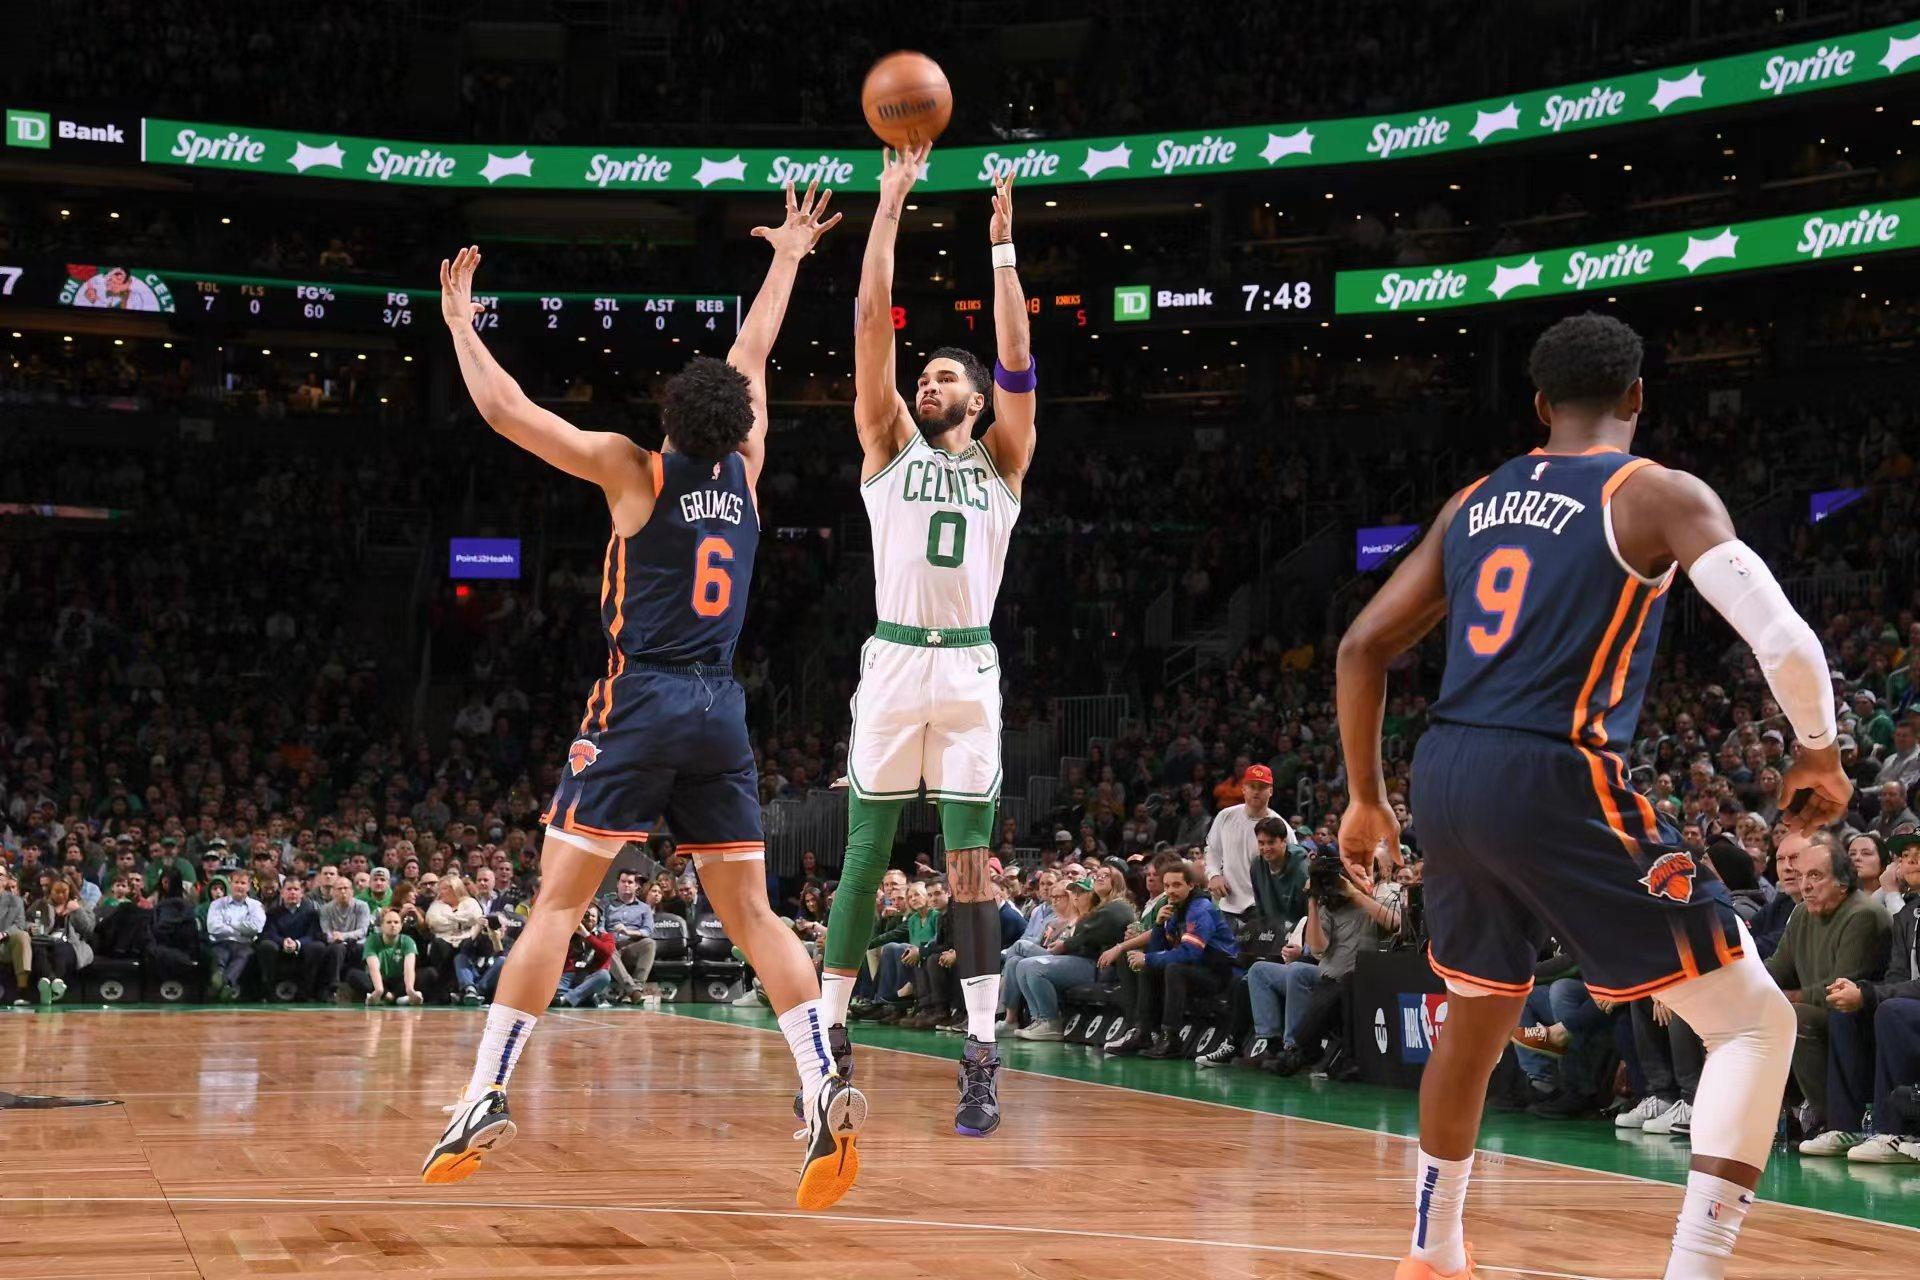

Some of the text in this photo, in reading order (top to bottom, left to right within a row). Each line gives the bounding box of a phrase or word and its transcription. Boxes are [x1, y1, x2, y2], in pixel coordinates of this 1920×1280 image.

[1759, 46, 1855, 95] Sprite
[877, 98, 937, 120] Wilson
[1539, 87, 1626, 132] Sprite
[11, 116, 124, 144] TD Bank
[171, 129, 265, 164] Sprite
[1366, 117, 1450, 158] Sprite
[366, 147, 456, 180] Sprite
[585, 153, 672, 187] Sprite
[767, 155, 854, 188] Sprite
[978, 148, 1060, 185] Sprite
[1151, 135, 1237, 174] Sprite
[1796, 209, 1900, 258] Sprite
[1562, 244, 1654, 290] Sprite
[196, 281, 220, 293] TOL
[241, 285, 265, 296] FLS
[297, 286, 335, 301] FG%
[387, 293, 409, 306] FG
[541, 298, 563, 311] TO
[594, 298, 620, 311] STL
[645, 298, 675, 312] AST
[696, 300, 725, 313] REB
[1118, 288, 1213, 314] TD Bank
[1241, 281, 1312, 312] 7:48
[1375, 269, 1468, 310] Sprite
[204, 296, 215, 311] 7
[250, 300, 261, 314] 0
[304, 303, 325, 319] 60
[383, 309, 411, 328] 3/5
[547, 314, 558, 329] 2
[602, 315, 613, 329] 0
[655, 316, 665, 330] 0
[706, 316, 716, 330] 4
[966, 315, 975, 331] 7
[1077, 310, 1087, 326] 5
[958, 445, 977, 459] VISTA
[902, 459, 989, 512] CELTICS
[680, 490, 744, 525] GRIMES
[1468, 490, 1586, 537] BARRETT
[926, 510, 967, 568] 0
[691, 535, 736, 617] 6
[1466, 544, 1532, 657] 9
[1403, 1008, 1424, 1049] NBA
